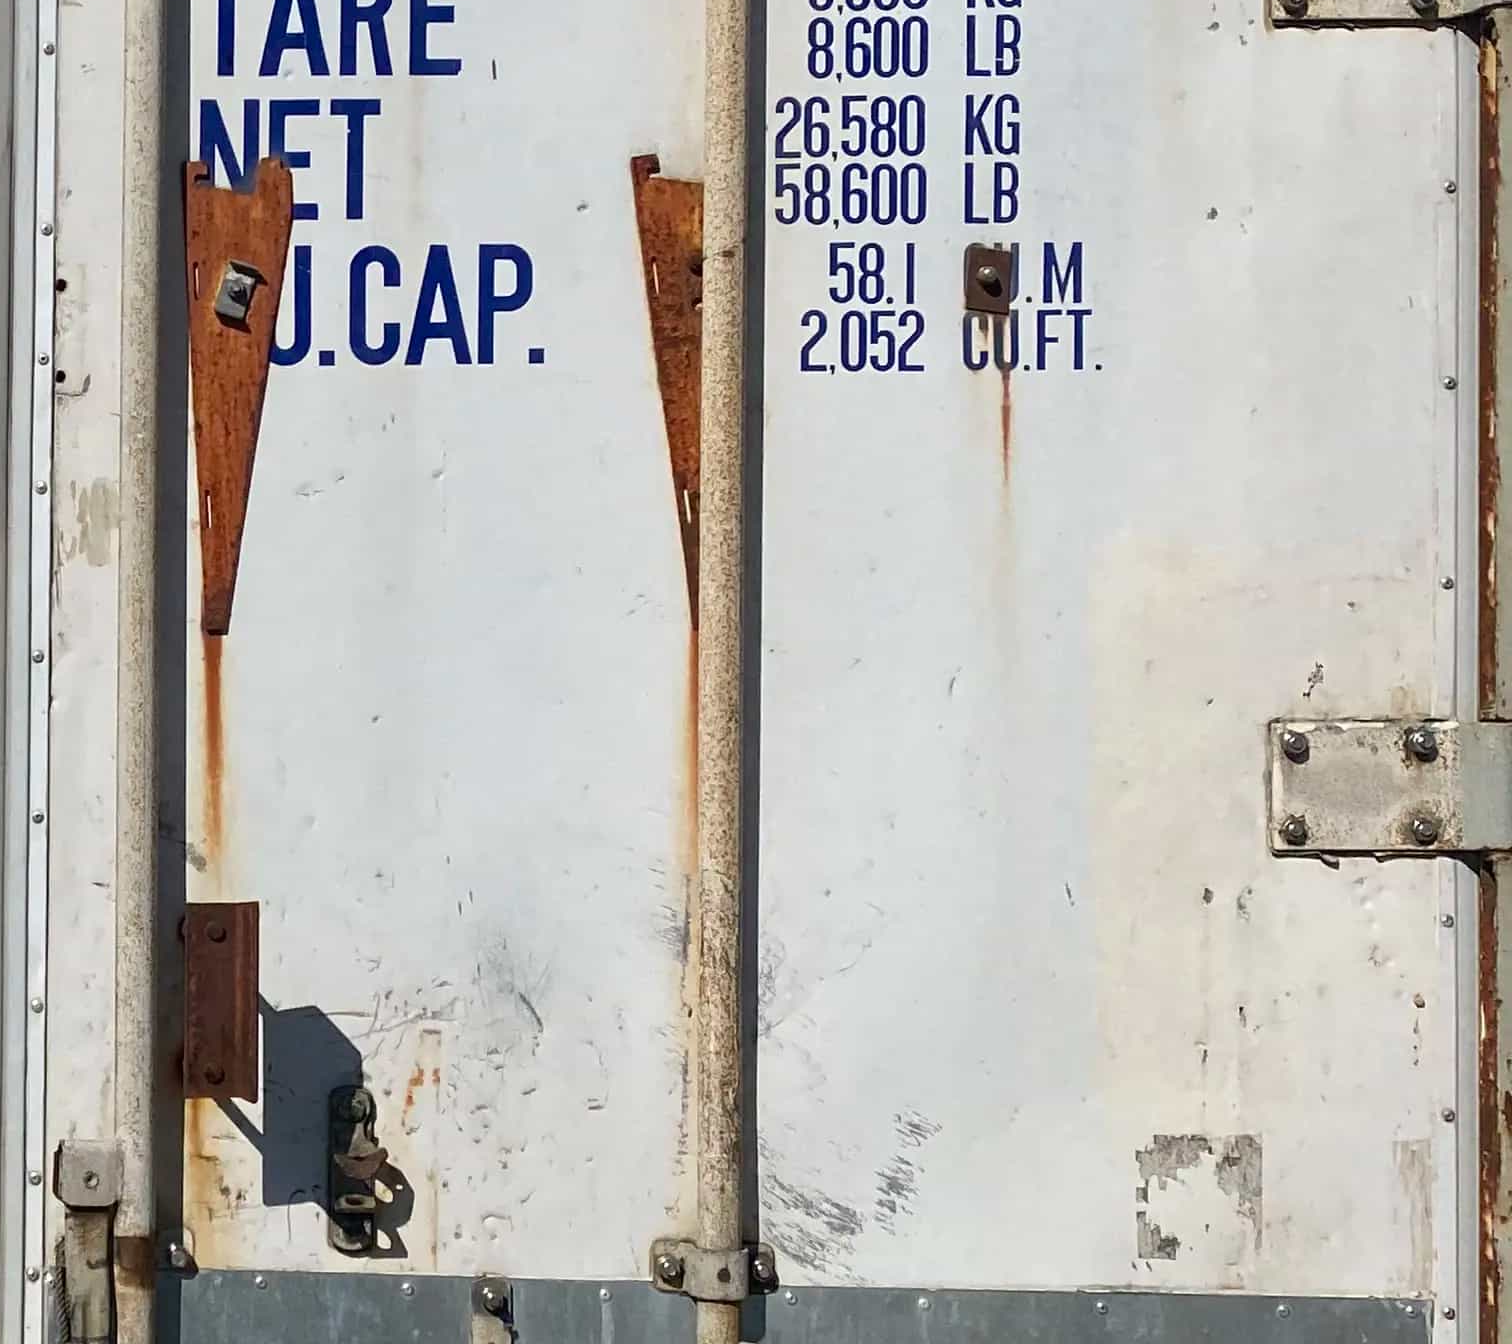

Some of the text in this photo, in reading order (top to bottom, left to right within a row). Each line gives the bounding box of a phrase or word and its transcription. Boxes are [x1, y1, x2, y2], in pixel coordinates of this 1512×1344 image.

[807, 14, 1022, 83] 8,600 LB
[199, 93, 1021, 222] NET 26,580 KG
[774, 161, 1019, 230] 58,600 LB
[270, 242, 546, 368] U.CAP.
[799, 309, 925, 375] 2,052
